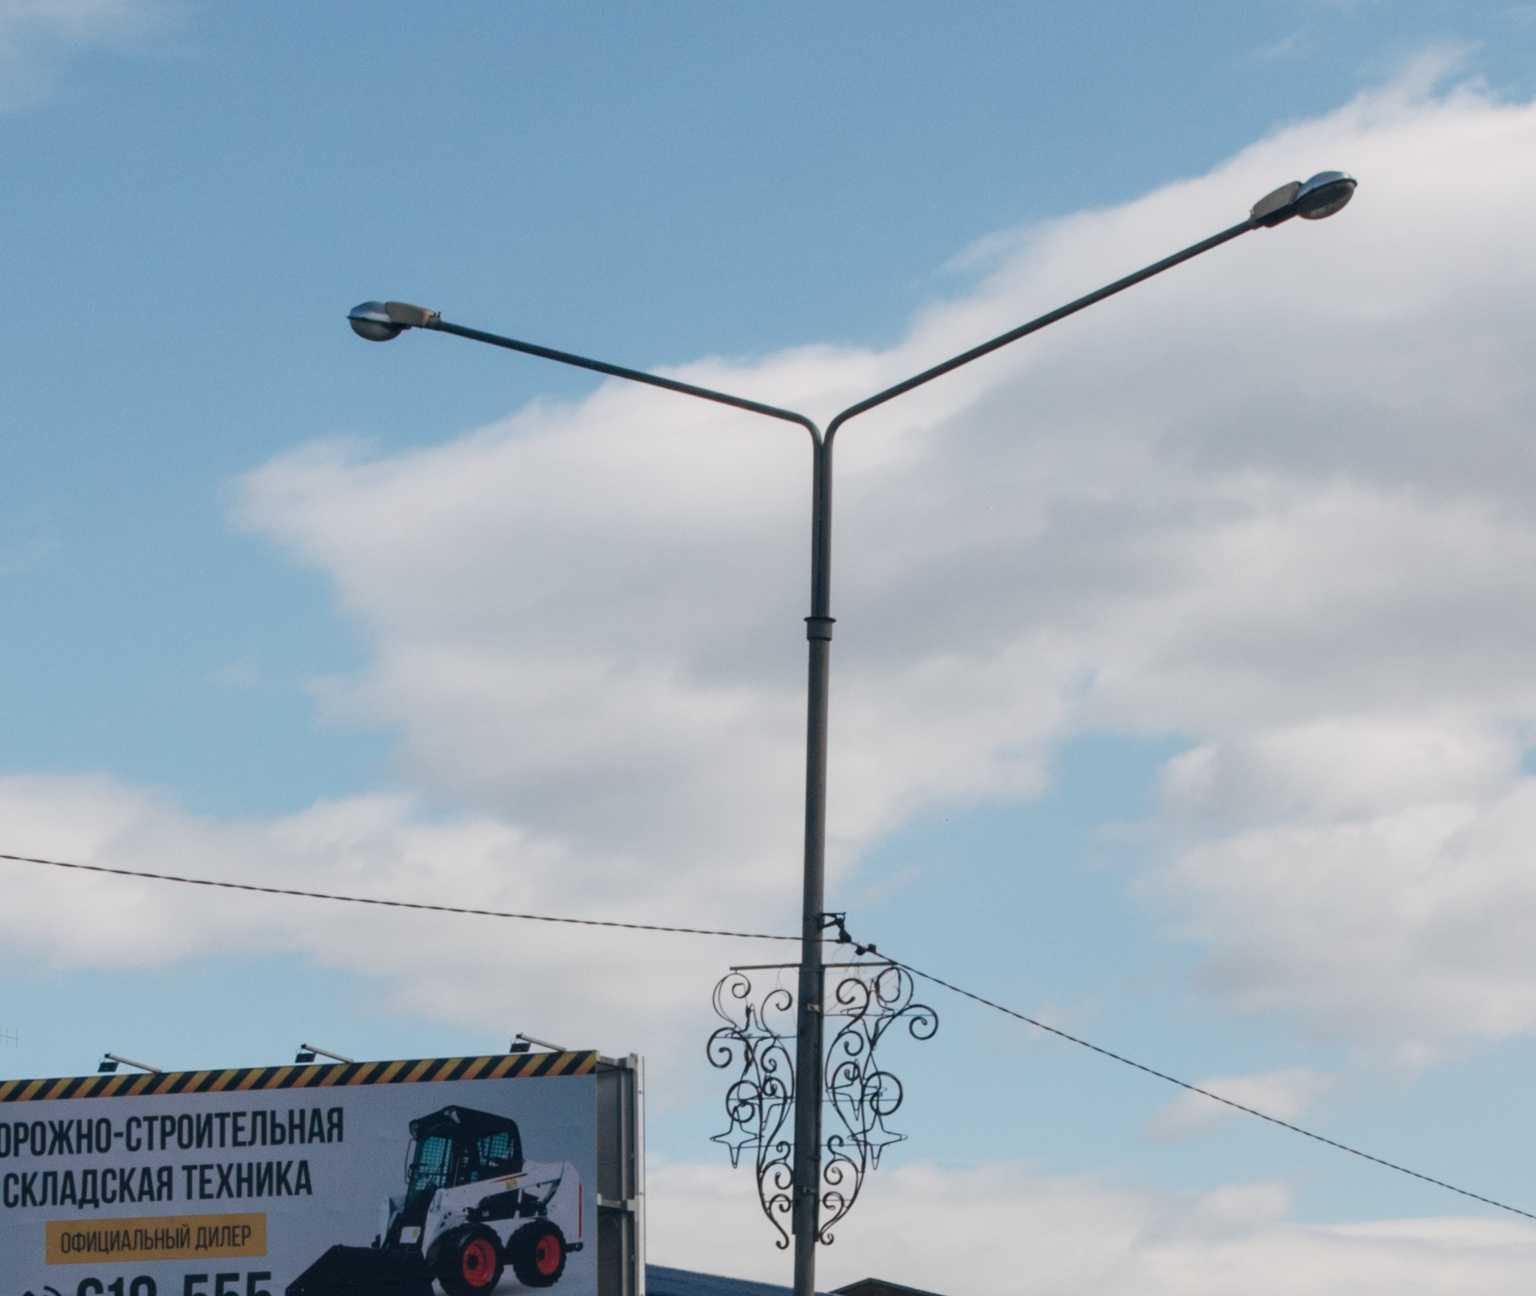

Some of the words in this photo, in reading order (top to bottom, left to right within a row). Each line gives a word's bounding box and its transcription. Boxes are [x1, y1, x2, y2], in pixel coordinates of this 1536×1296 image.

[2, 1166, 173, 1209] СКЛАДСКАЯ
[181, 1160, 313, 1200] ТЕХНИКА
[60, 1224, 191, 1255] ОФИЦИАЛЬНЫЙ
[194, 1224, 252, 1251] ДИЛЕР
